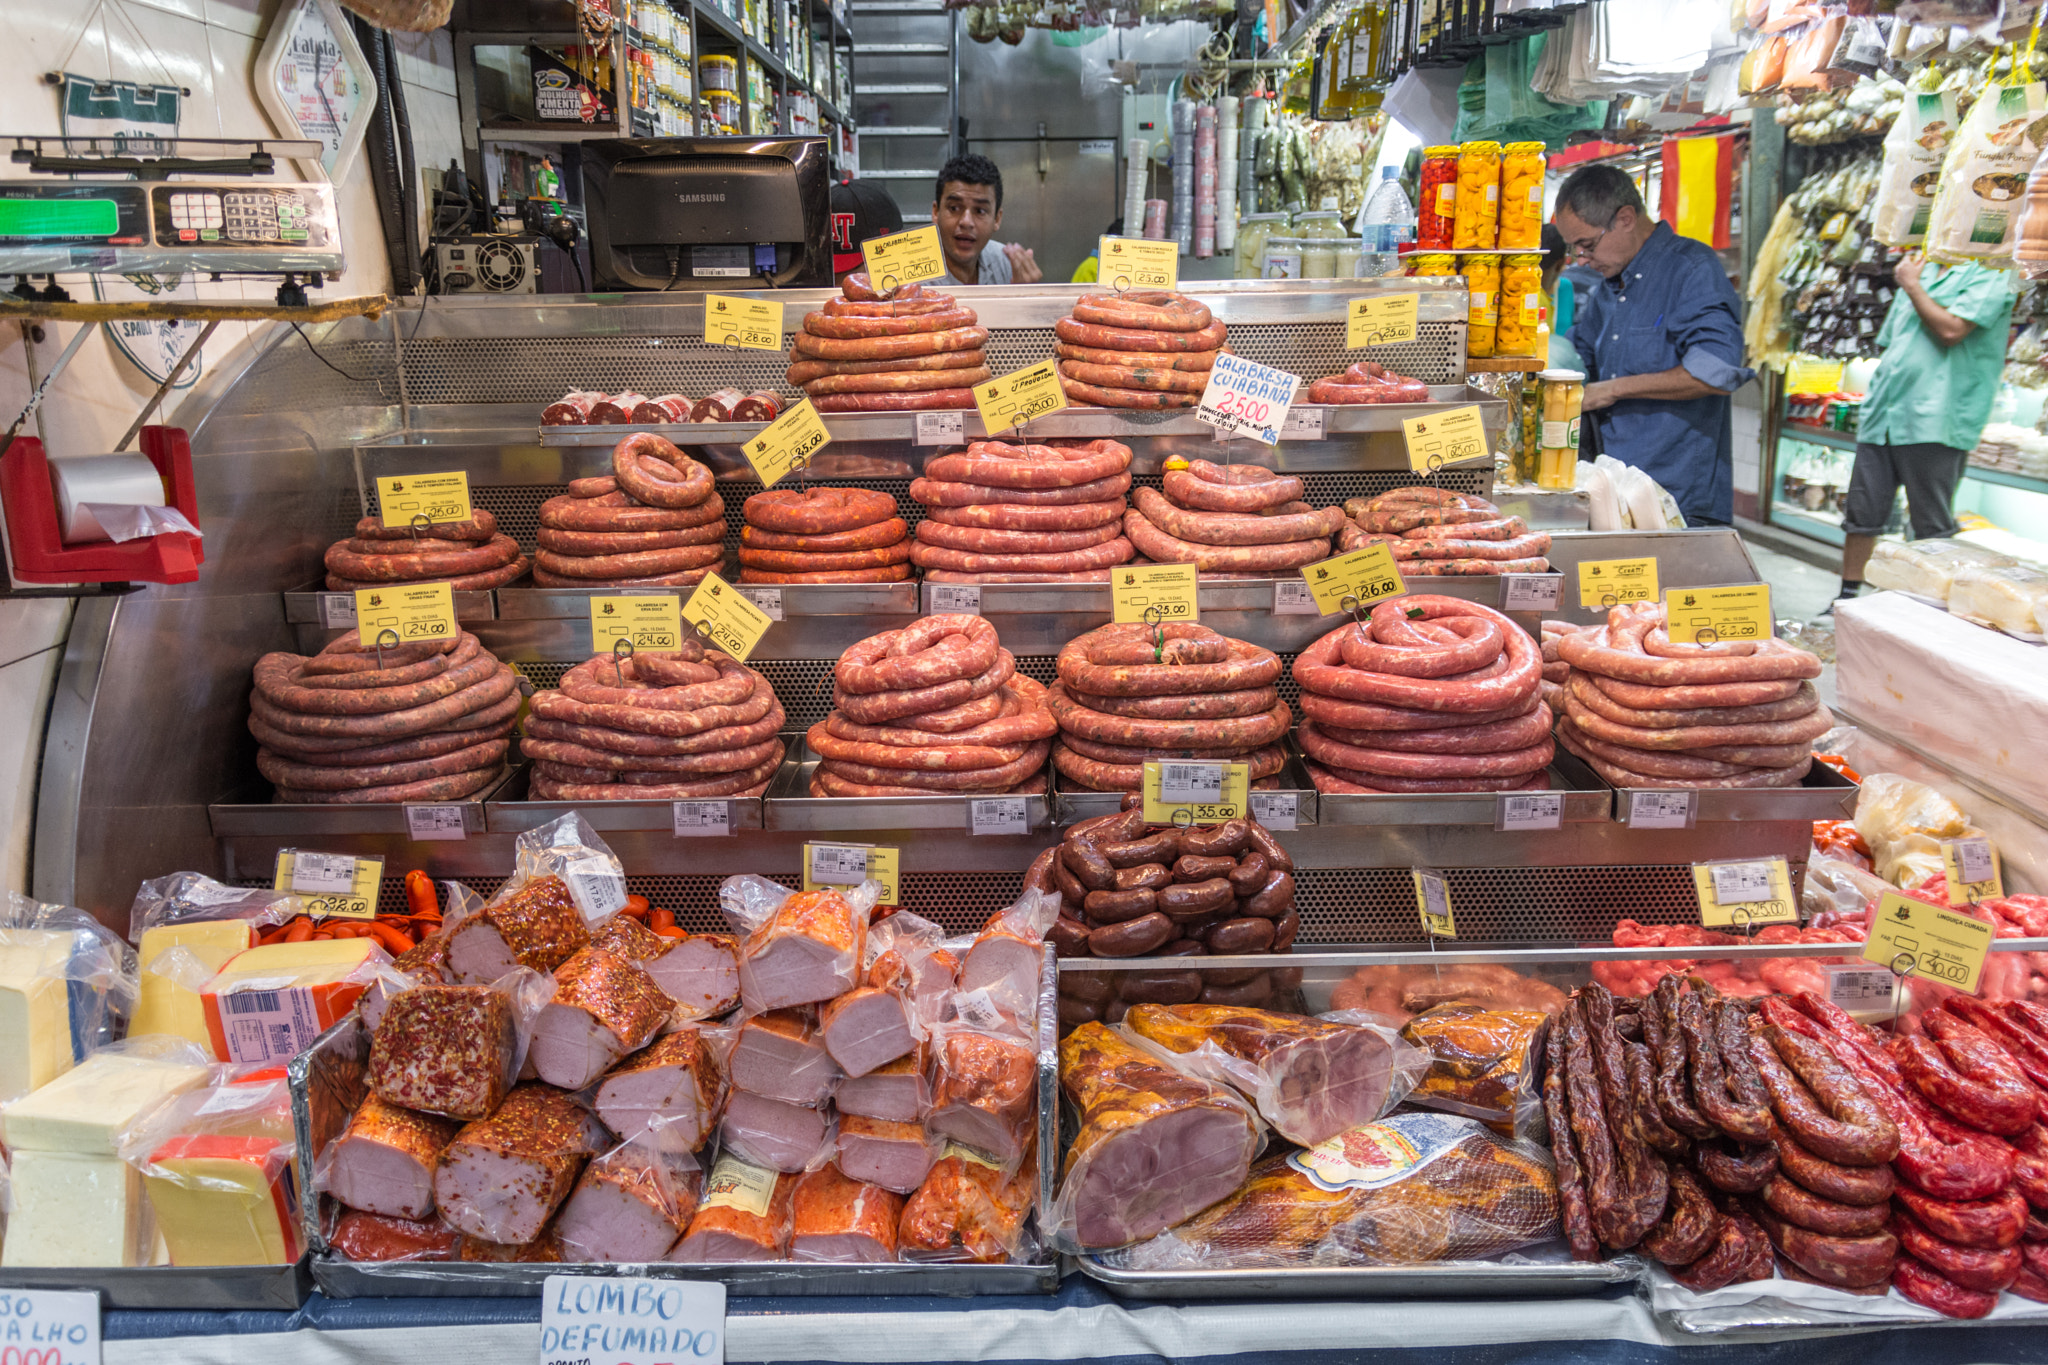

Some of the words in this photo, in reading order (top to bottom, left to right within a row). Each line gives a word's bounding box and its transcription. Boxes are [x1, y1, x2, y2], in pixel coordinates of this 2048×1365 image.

[353, 83, 359, 95] 3
[540, 91, 568, 99] MOLHO
[569, 91, 579, 99] DE
[538, 99, 581, 109] PIMENTA
[342, 112, 348, 123] 4
[541, 109, 579, 117] CREMOSO
[332, 138, 339, 151] 5
[1974, 150, 2005, 163] Funghi
[679, 193, 726, 203] SAMSUNG
[1215, 355, 1294, 390] CALABRESA
[1213, 373, 1292, 407] CUIABANA
[408, 623, 445, 635] 24.00
[636, 634, 670, 646] 24.00
[714, 627, 742, 651] 24.00
[1198, 805, 1235, 818] 35.00
[589, 885, 603, 909] 17,85
[1937, 912, 1963, 926] LINGUIÇA
[1963, 920, 1988, 934] CURADA
[1926, 952, 1967, 981] 40,00
[285, 1034, 295, 1054] SAC
[0, 1294, 33, 1318] JO
[556, 1279, 684, 1321] LOMBO
[541, 1323, 718, 1358] DEFUMADO
